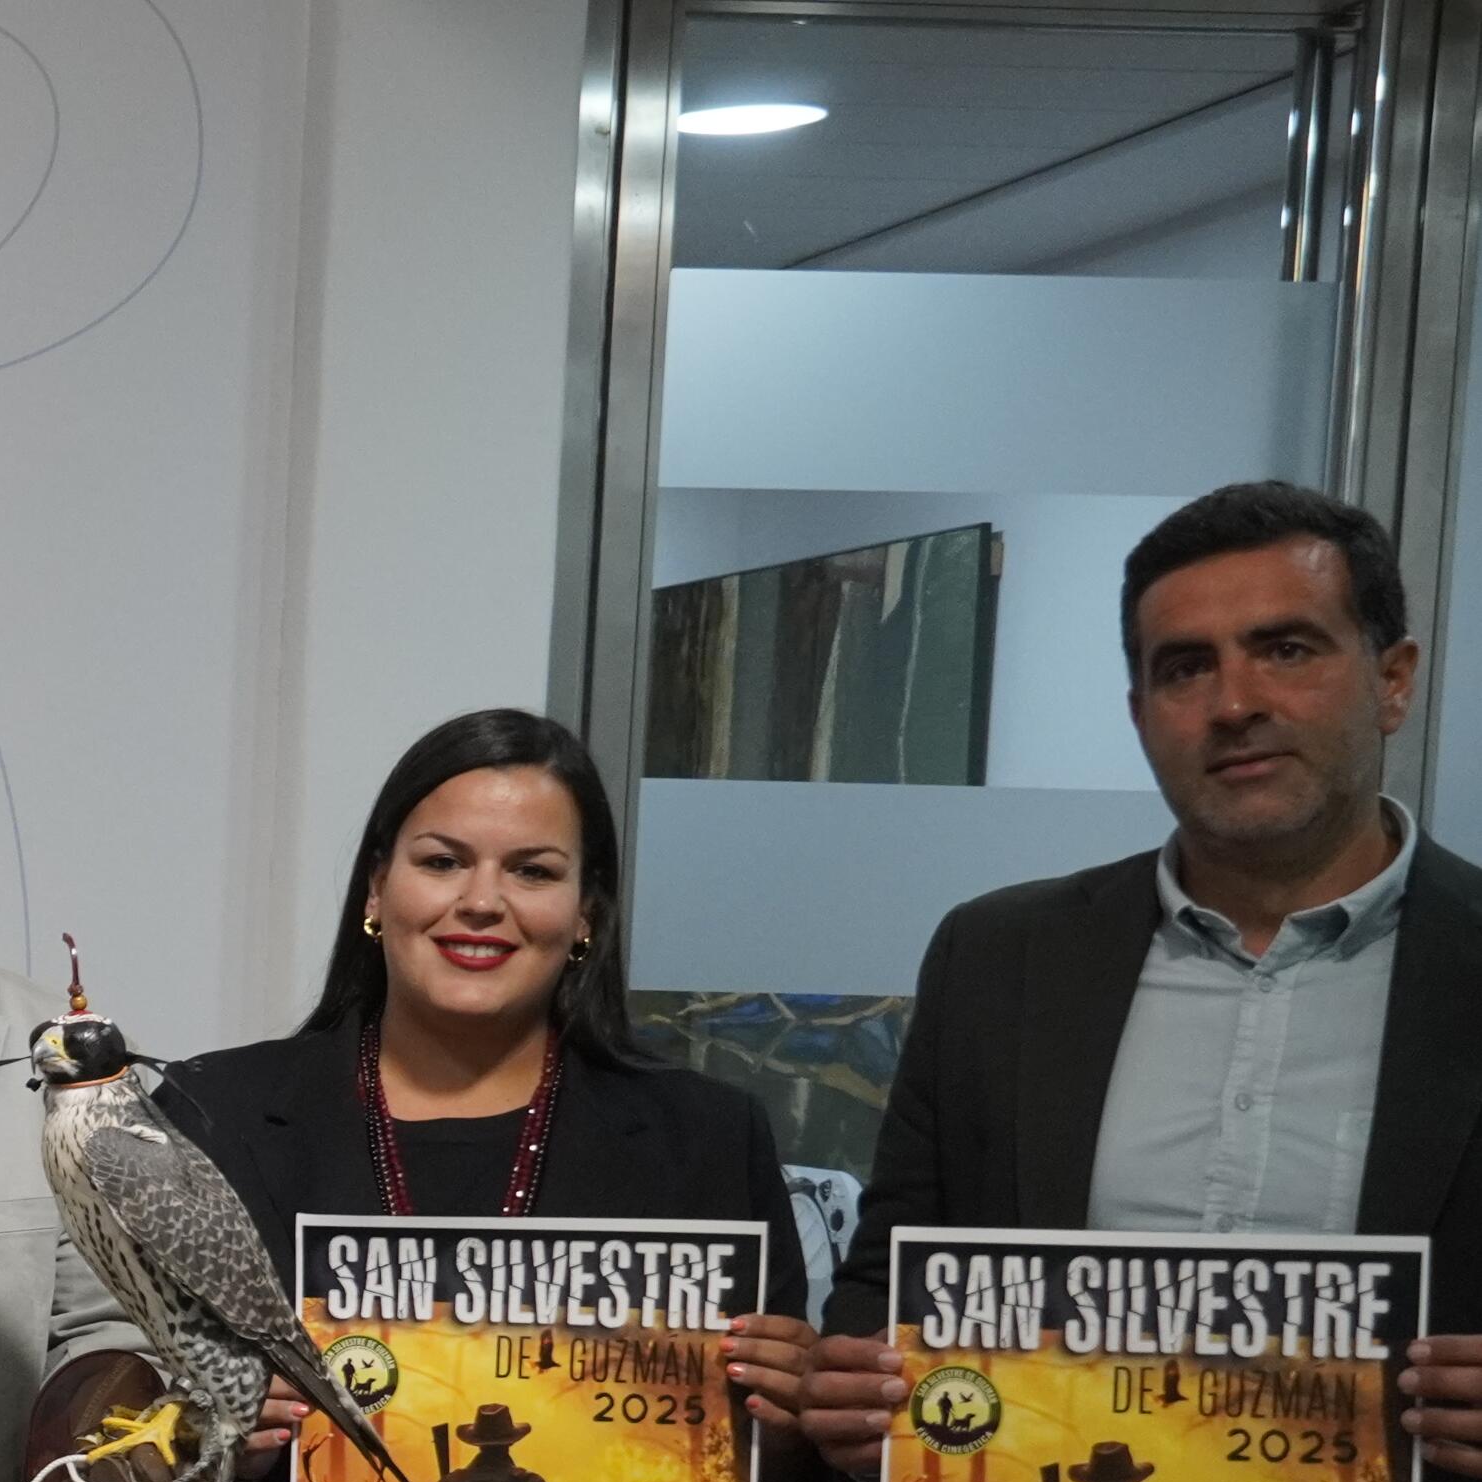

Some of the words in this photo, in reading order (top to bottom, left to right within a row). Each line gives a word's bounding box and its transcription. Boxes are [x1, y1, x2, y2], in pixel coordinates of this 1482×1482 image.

[327, 1234, 436, 1321] SAN
[454, 1236, 735, 1331] SILVESTRE
[923, 1251, 1044, 1352] SAN
[1065, 1254, 1392, 1360] SILVESTRE
[494, 1333, 531, 1380] DE
[568, 1333, 706, 1386] GUZMÁN
[592, 1392, 706, 1425] 2025
[1112, 1366, 1152, 1416] DE
[1198, 1361, 1357, 1421] GUZMÁN
[1225, 1428, 1359, 1466] 2025
